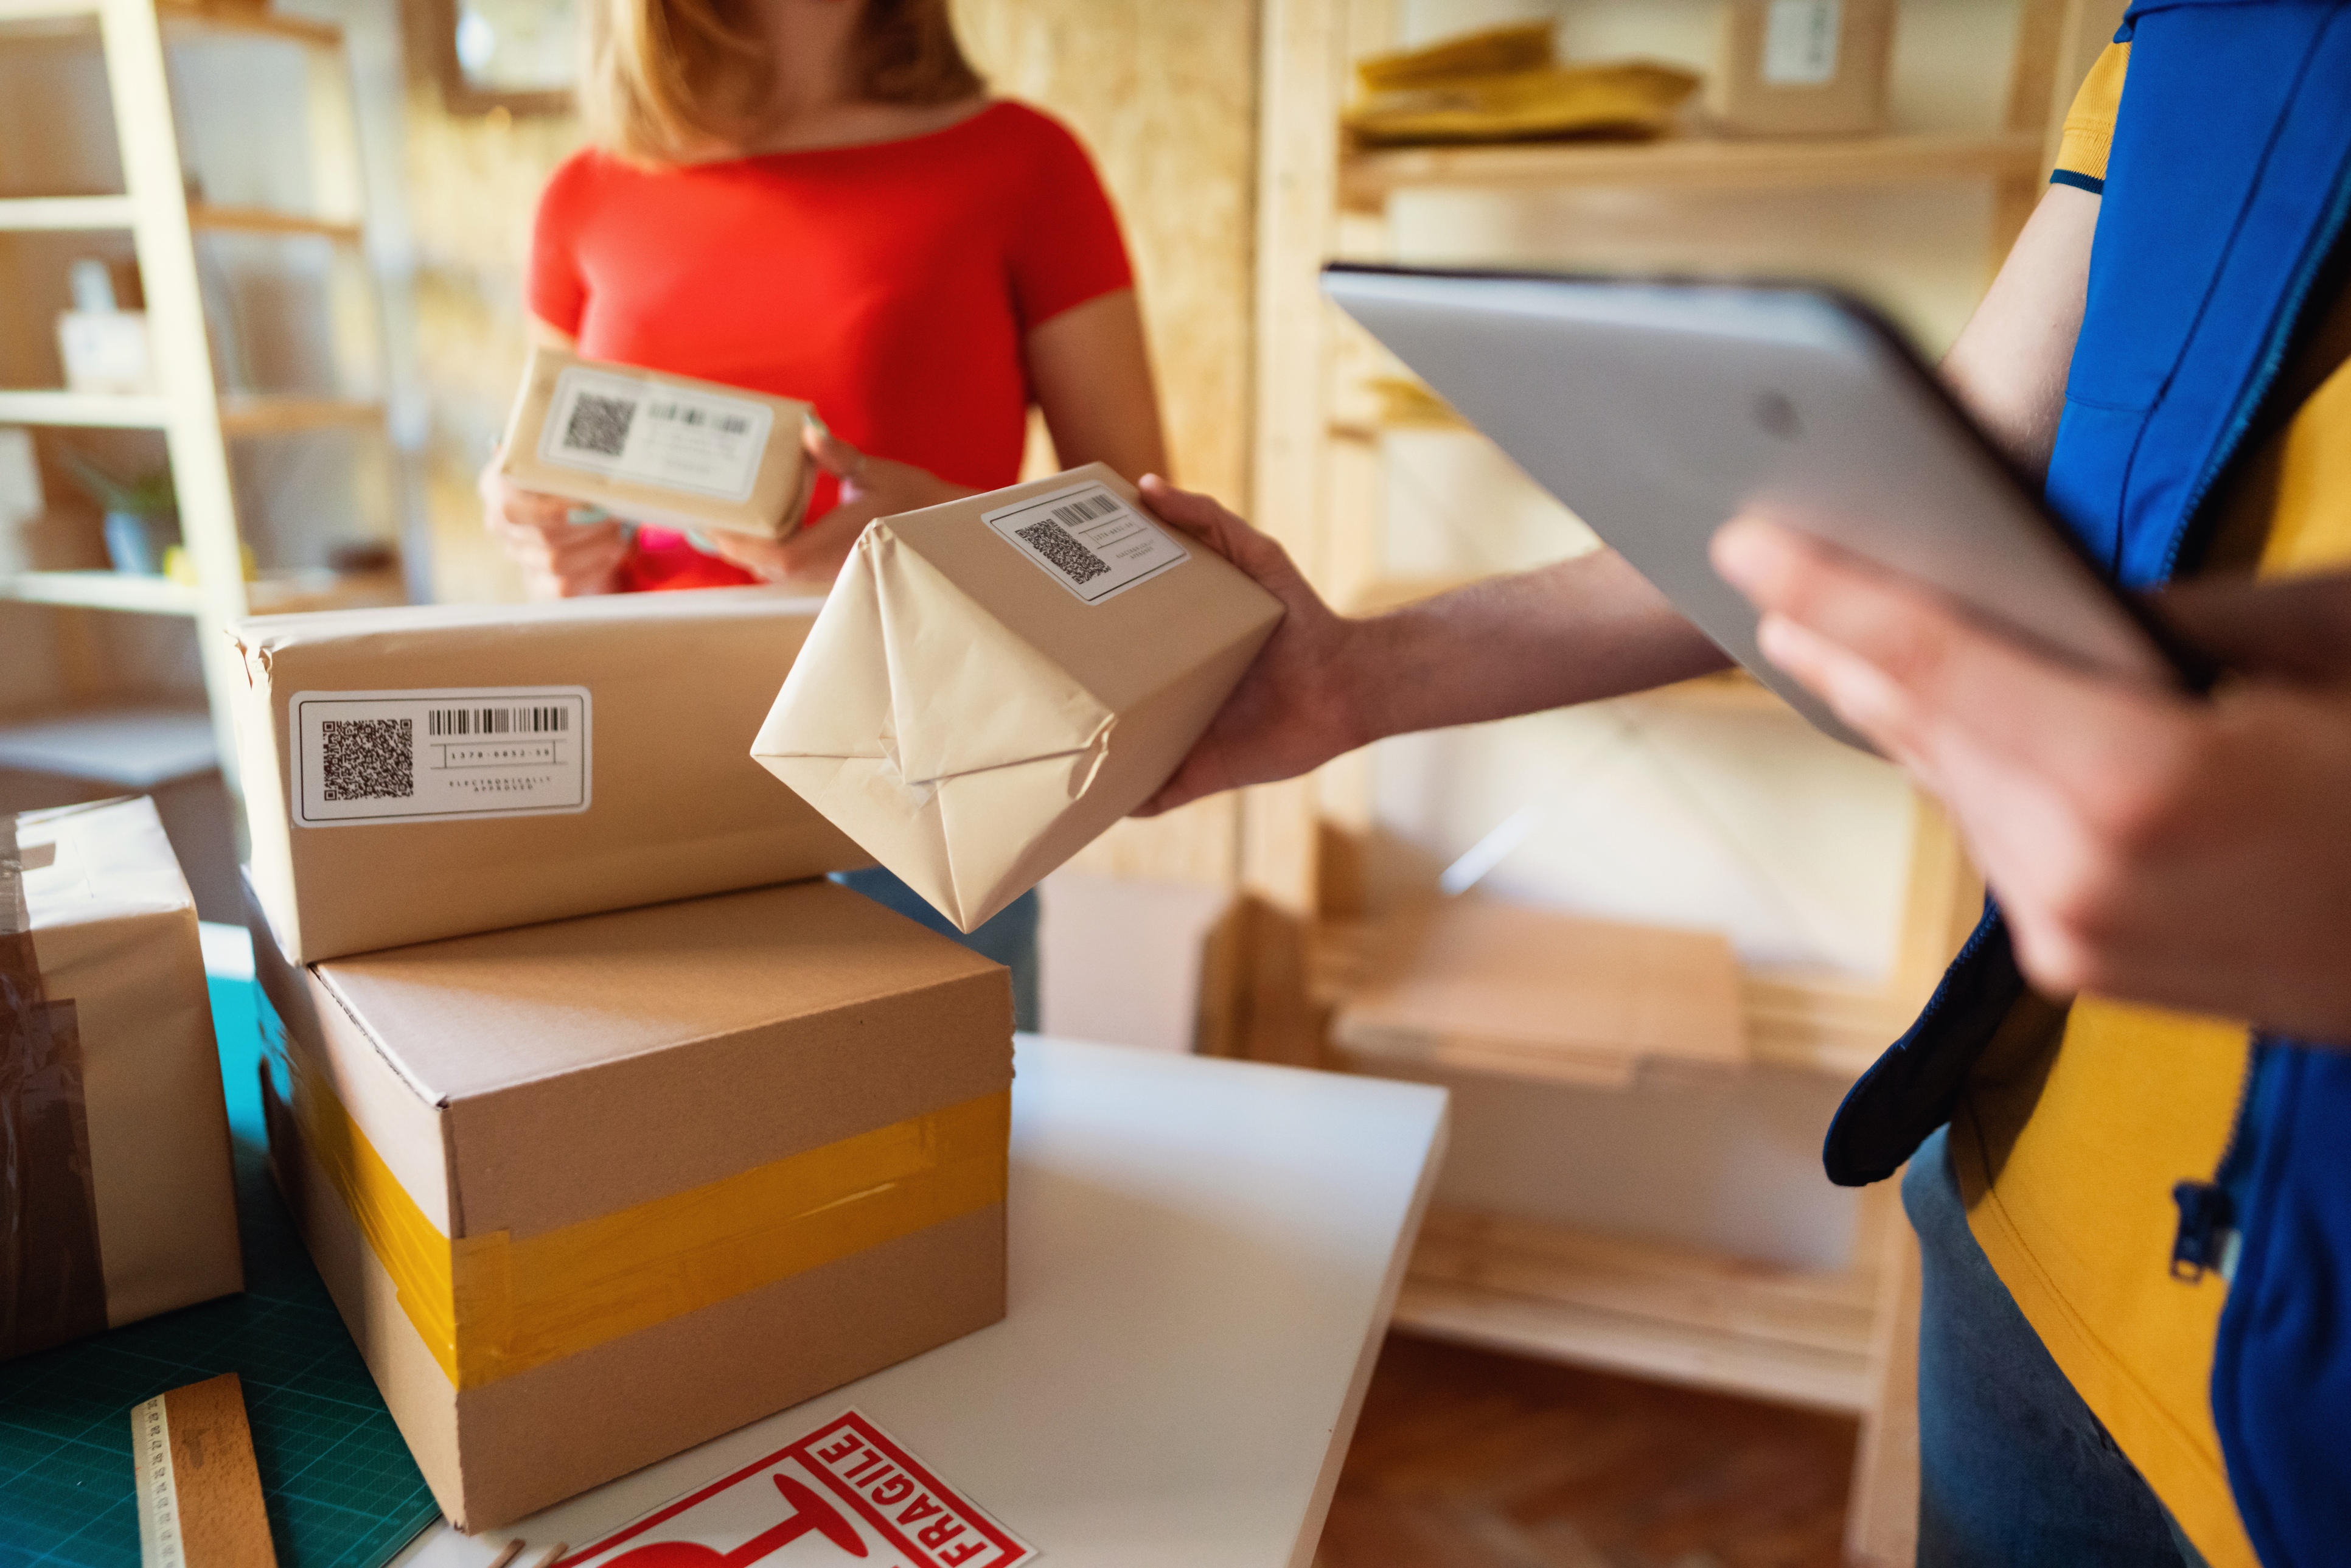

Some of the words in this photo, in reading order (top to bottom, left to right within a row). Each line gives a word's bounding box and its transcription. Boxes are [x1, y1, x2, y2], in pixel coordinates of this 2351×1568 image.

[449, 776, 550, 787] ELECTRONICALLY
[474, 784, 533, 792] APPROVED
[148, 1412, 159, 1423] 29
[150, 1425, 161, 1437] 28
[152, 1440, 161, 1451] 27
[153, 1452, 163, 1465] 26
[154, 1466, 165, 1479] 25
[156, 1482, 167, 1494] 24
[816, 1433, 988, 1568] FRAGILE
